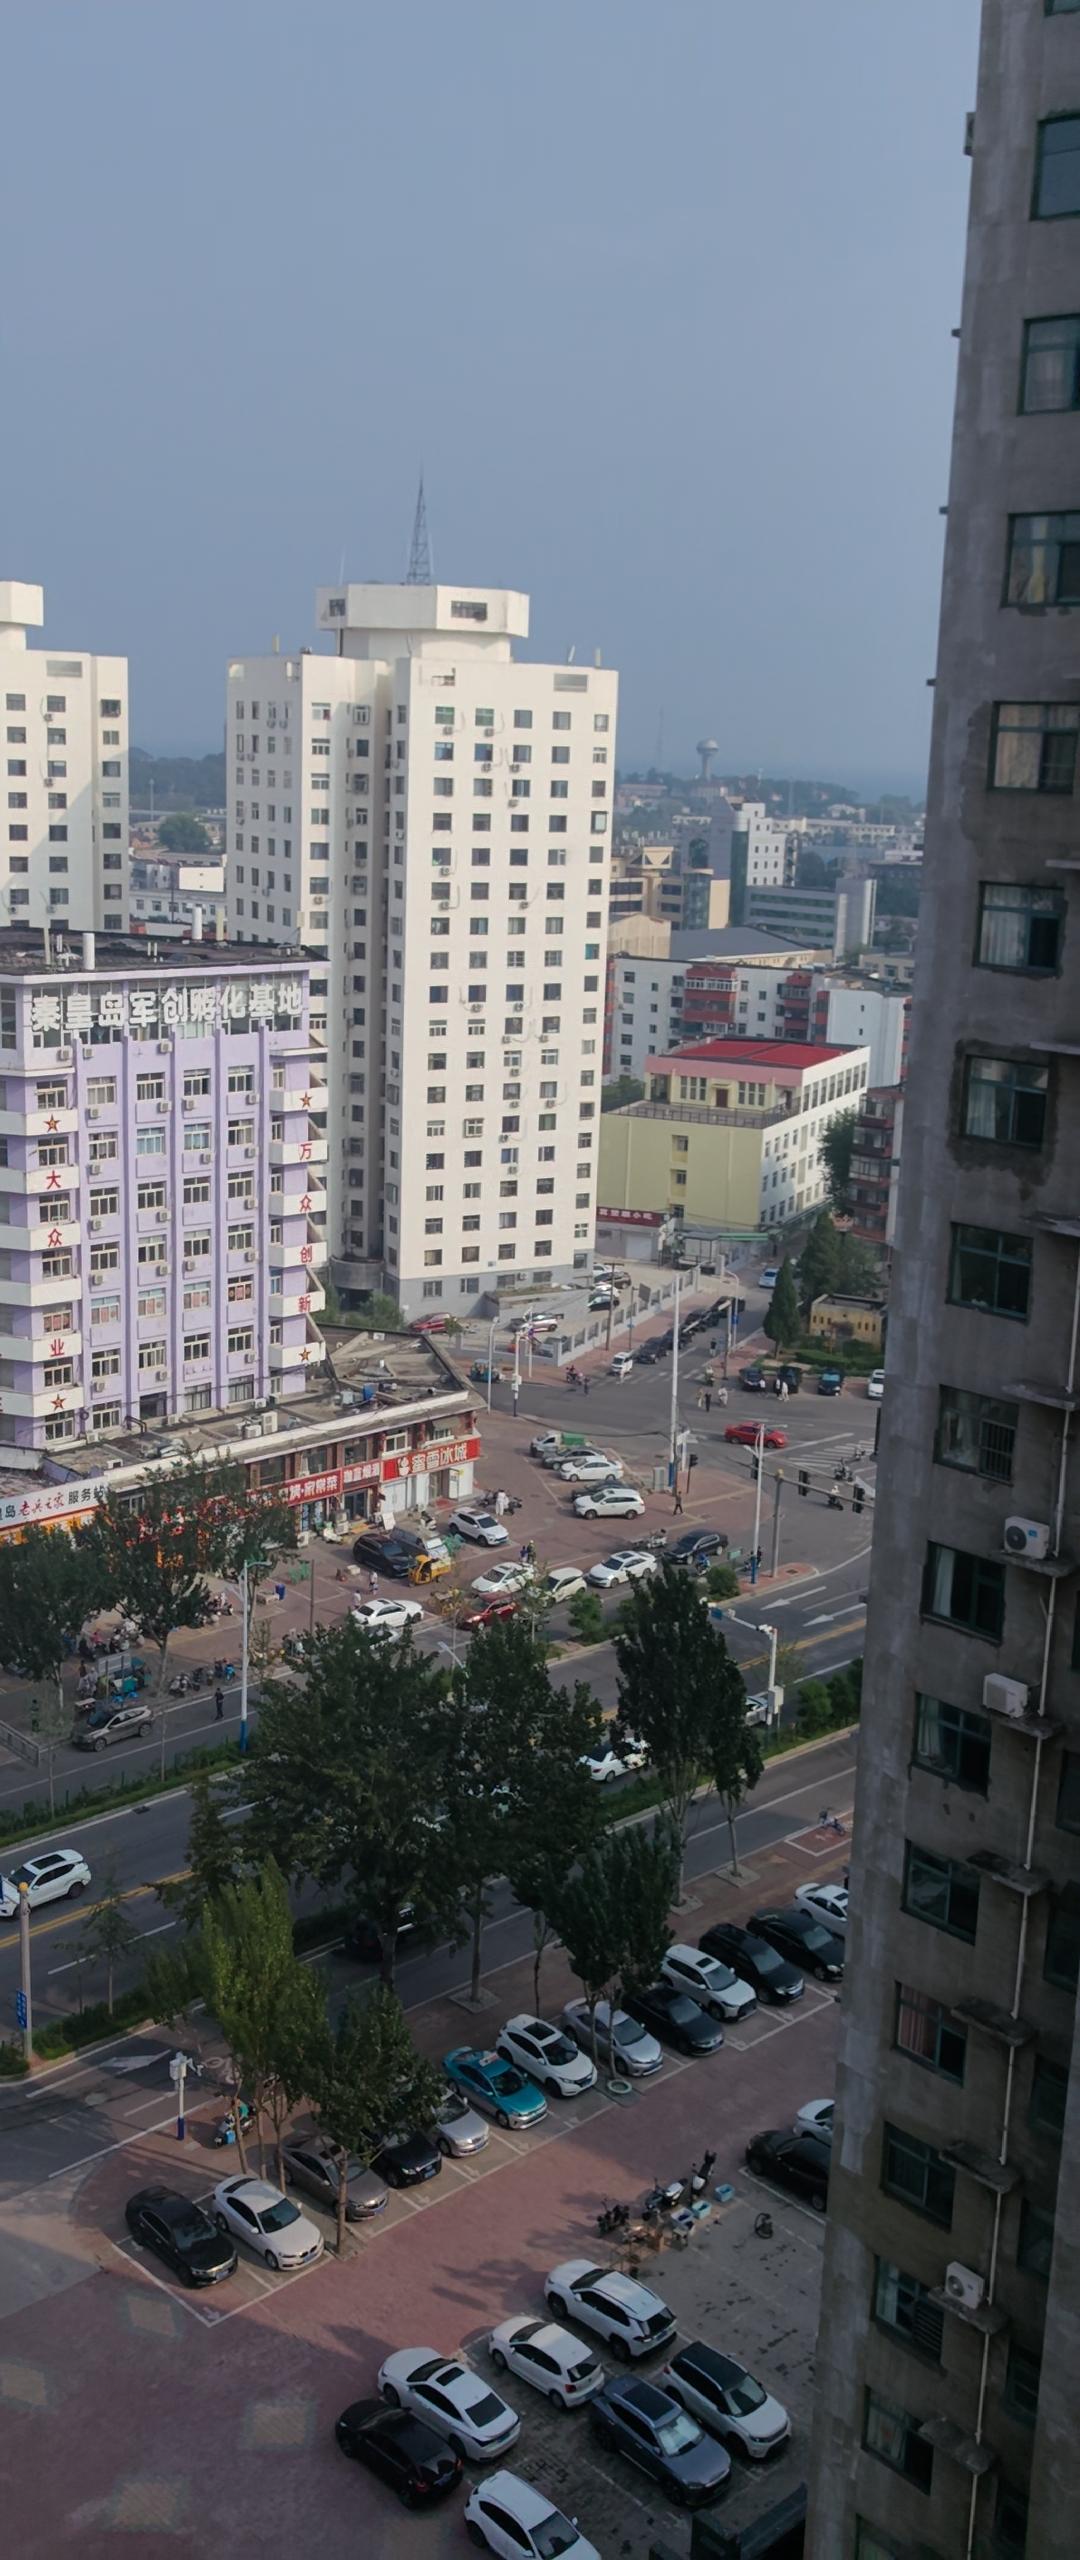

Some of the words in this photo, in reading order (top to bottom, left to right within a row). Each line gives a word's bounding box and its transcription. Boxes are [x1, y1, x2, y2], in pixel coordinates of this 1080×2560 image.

[30, 982, 303, 1032] 秦皇岛军创孵化基地
[411, 1442, 468, 1473] 蜜雪冰城
